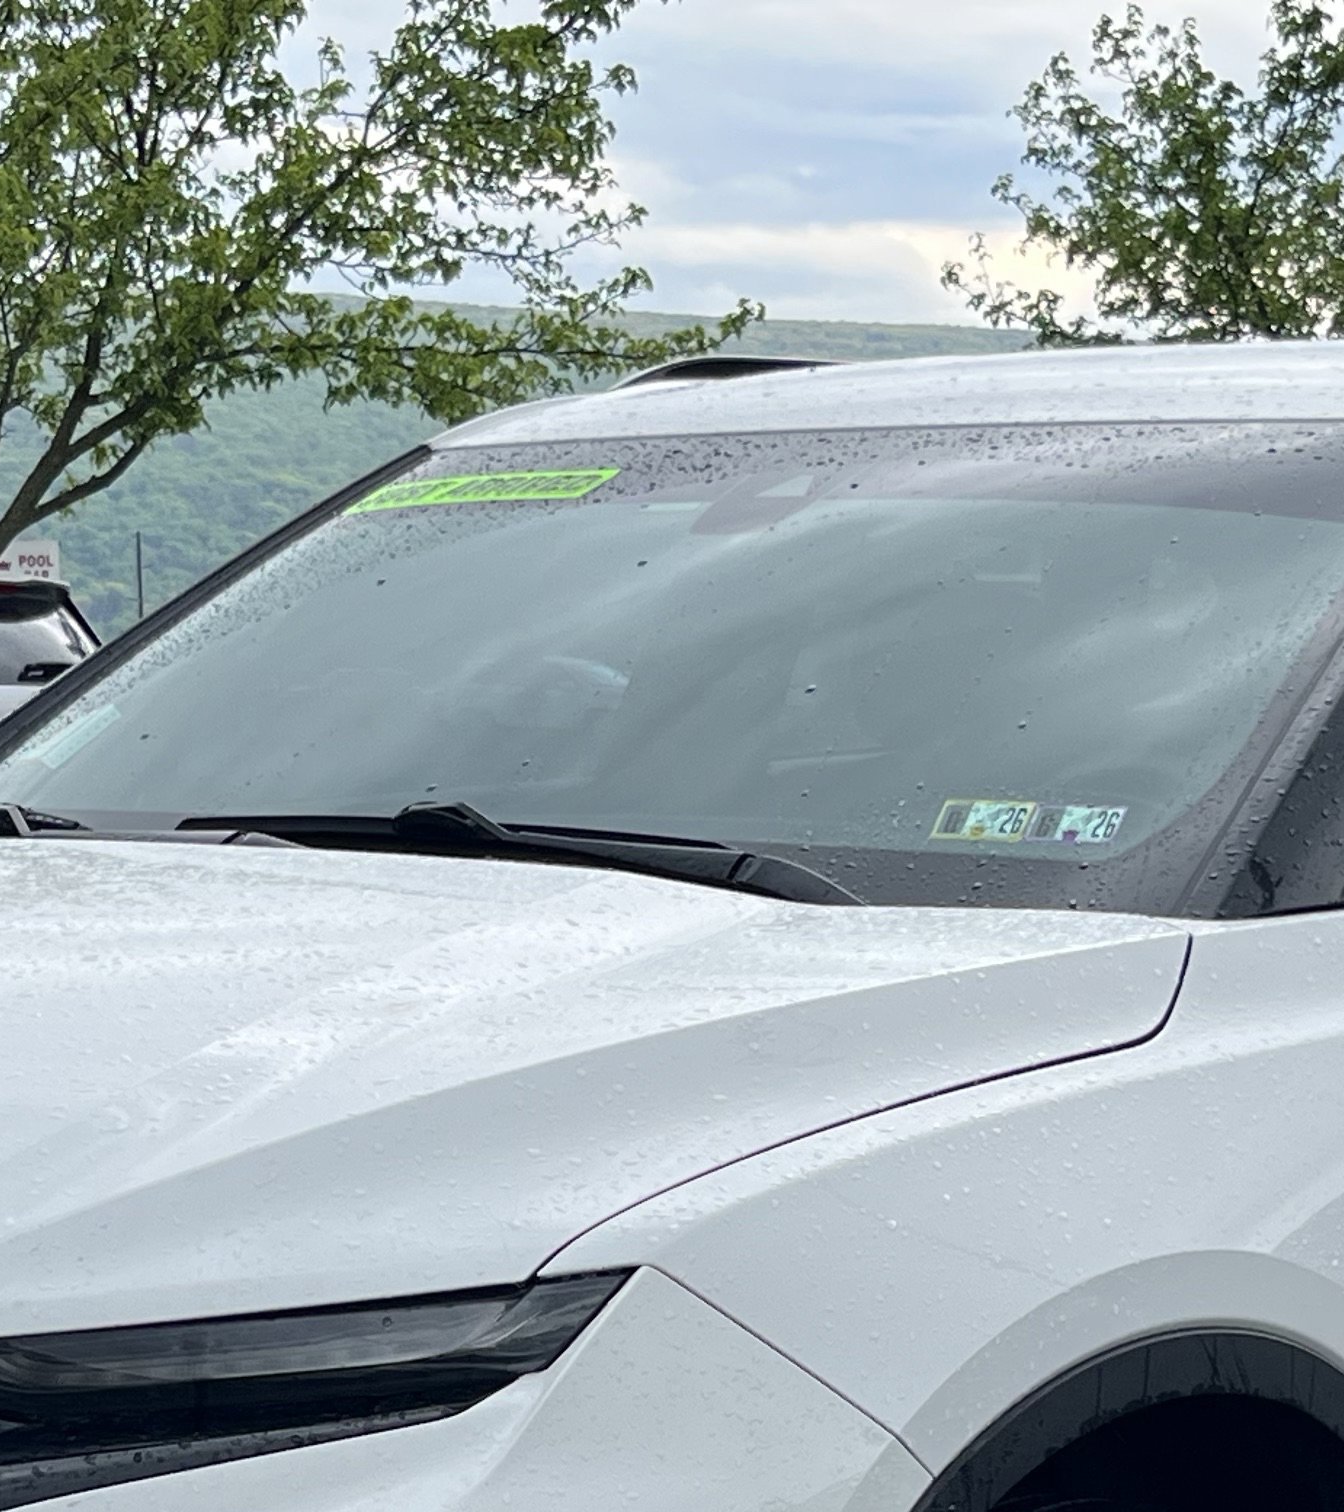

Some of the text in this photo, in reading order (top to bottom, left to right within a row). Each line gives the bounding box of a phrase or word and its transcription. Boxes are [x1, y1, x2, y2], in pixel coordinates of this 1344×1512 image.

[18, 555, 53, 568] POOL
[998, 807, 1028, 834] 26
[1090, 811, 1121, 839] 26
